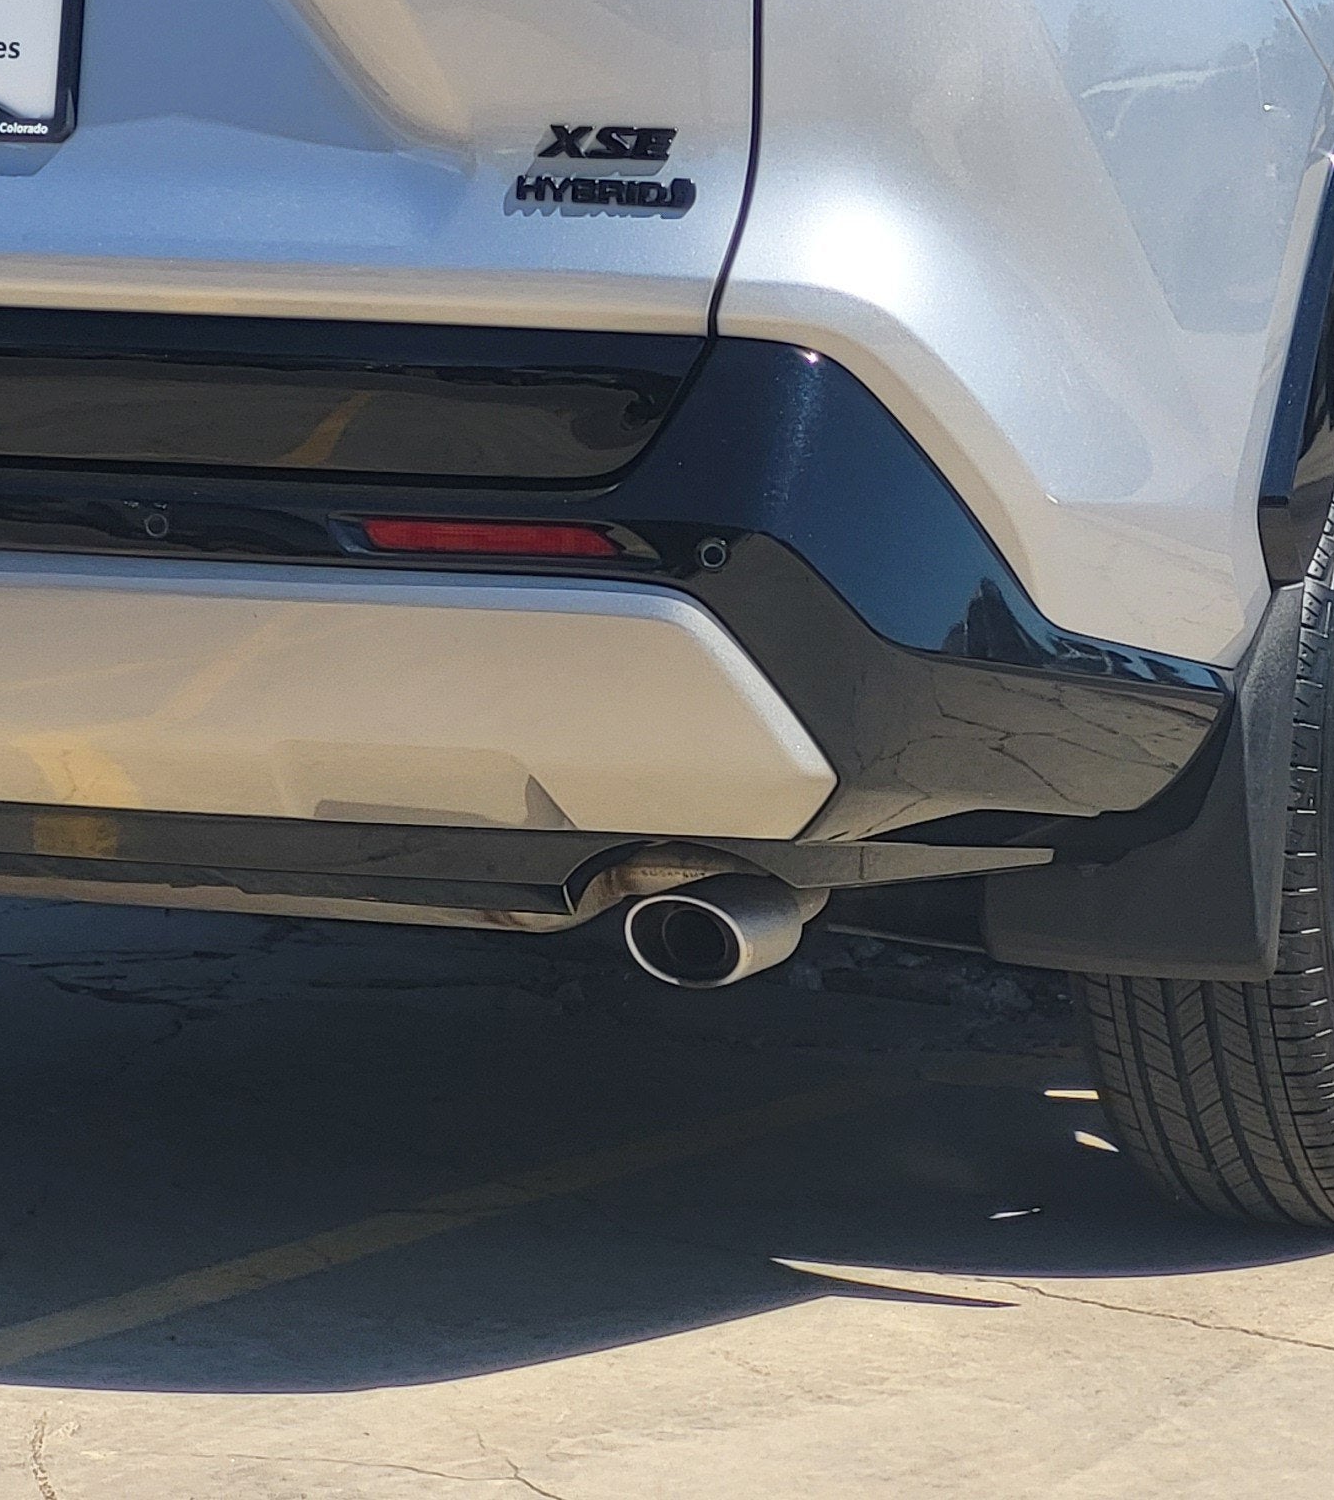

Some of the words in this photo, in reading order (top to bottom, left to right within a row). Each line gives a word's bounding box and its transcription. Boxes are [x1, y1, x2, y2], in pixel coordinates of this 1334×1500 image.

[0, 121, 49, 135] Colorado
[537, 123, 679, 161] XSE
[515, 175, 673, 208] HYBRID
